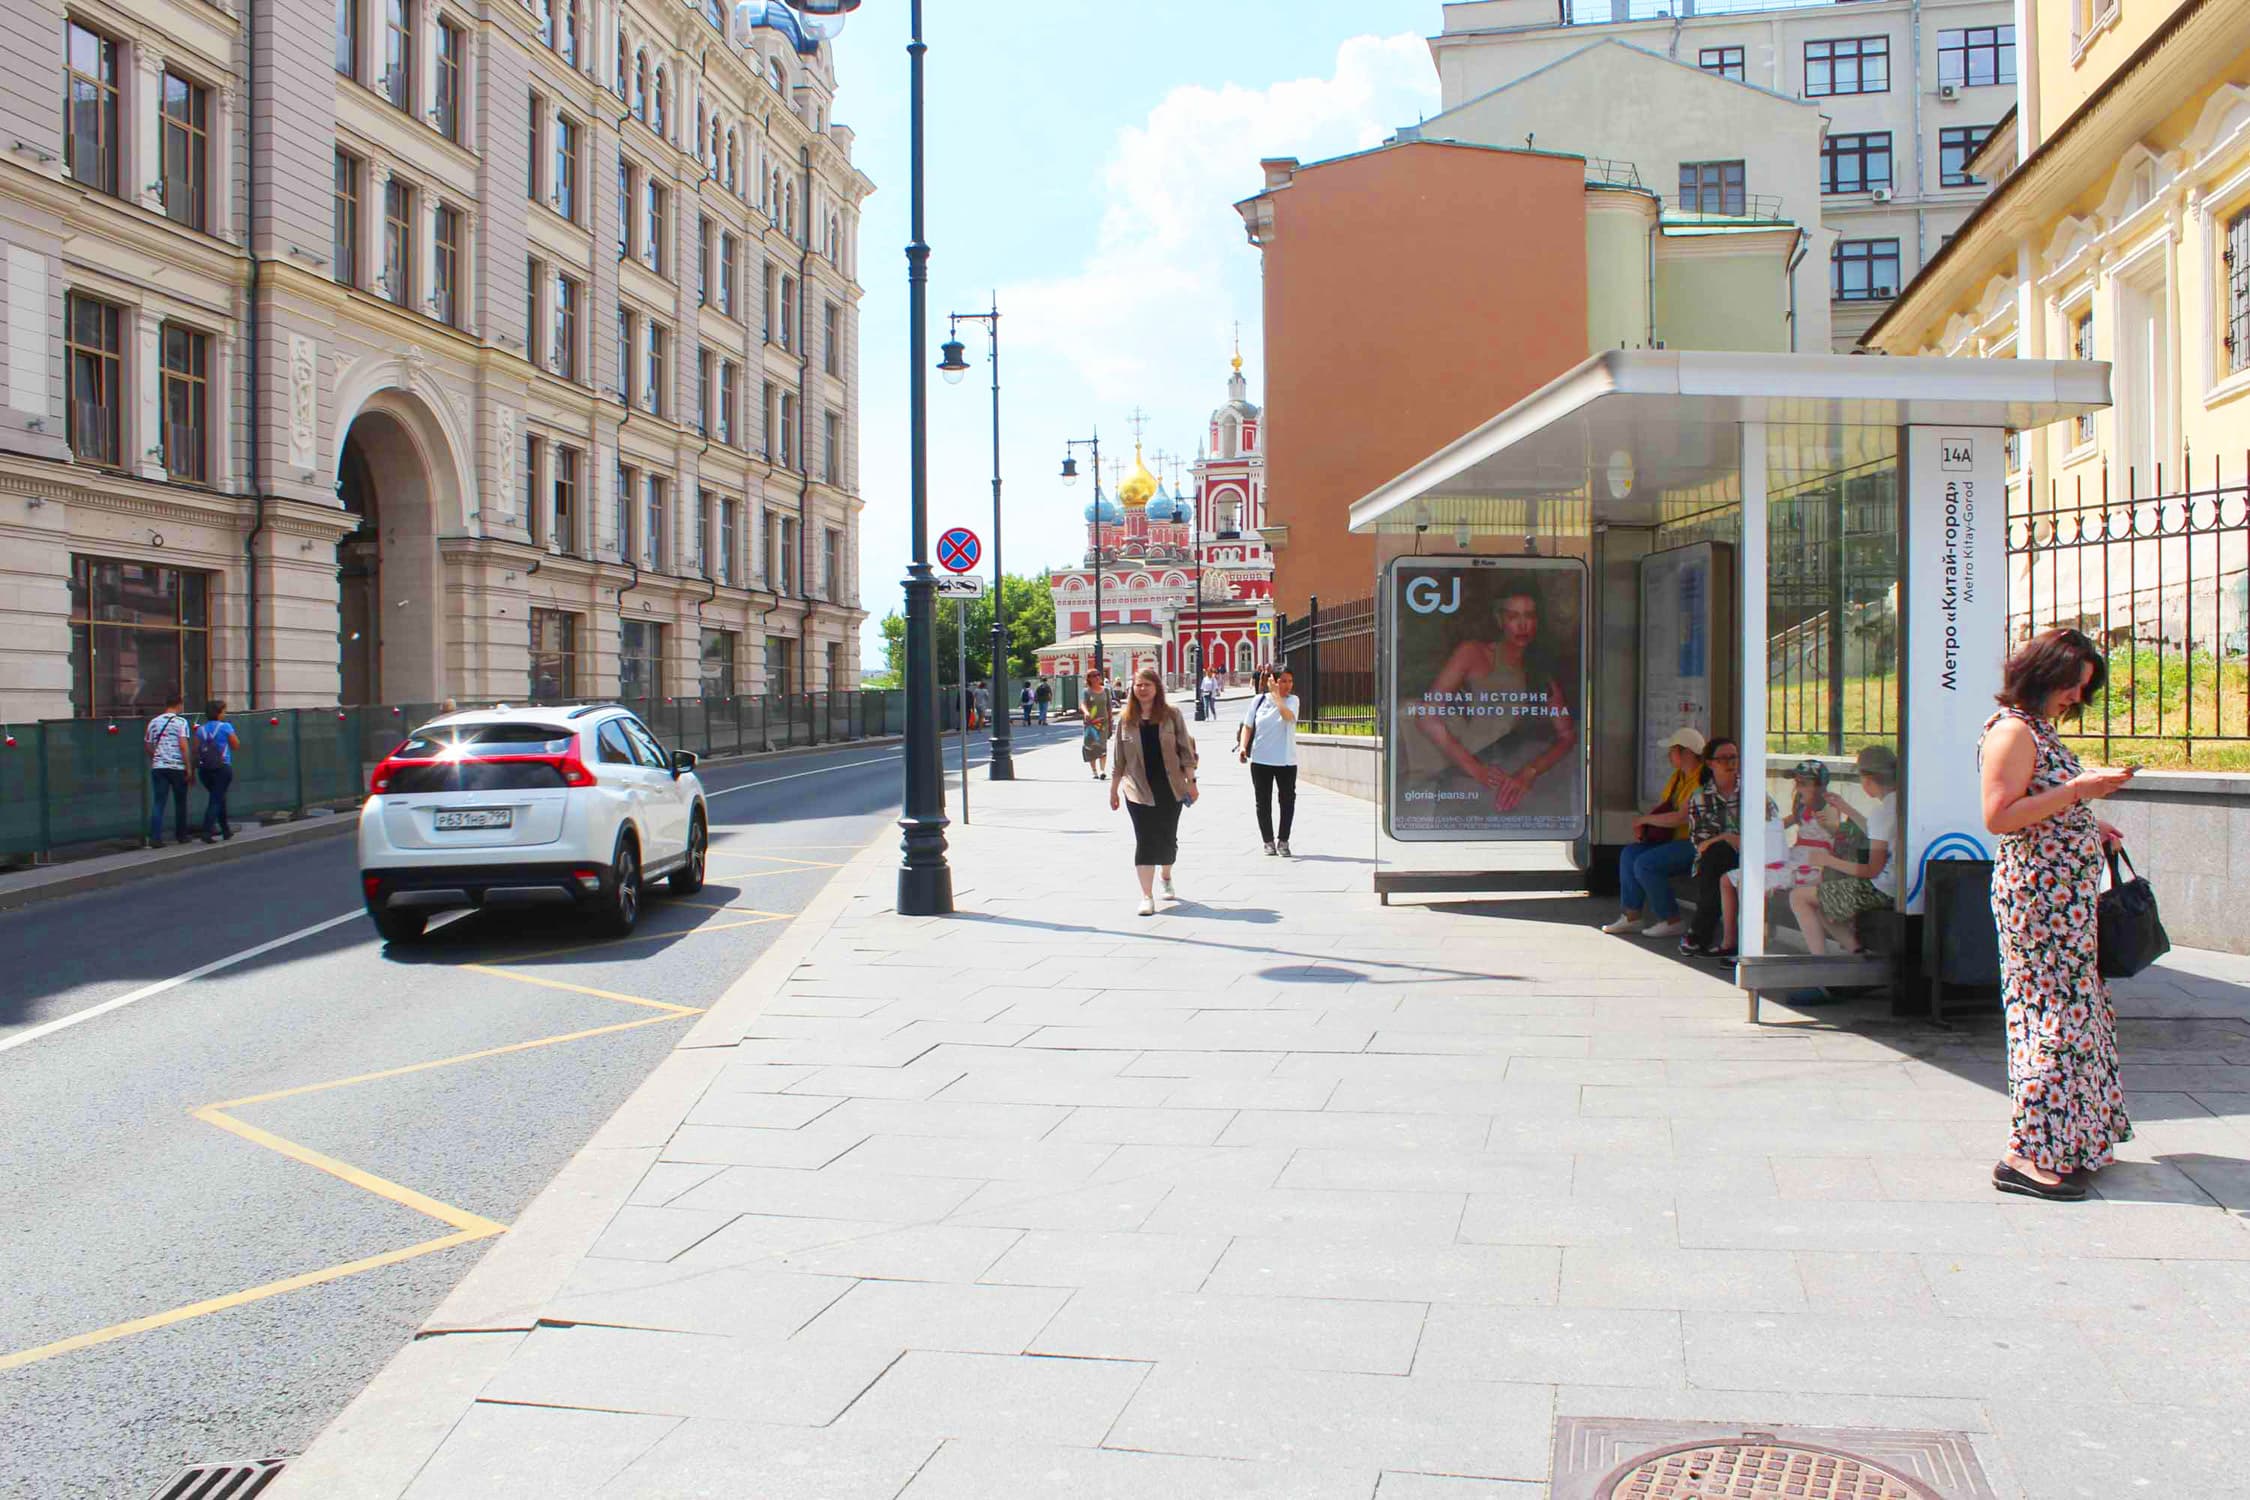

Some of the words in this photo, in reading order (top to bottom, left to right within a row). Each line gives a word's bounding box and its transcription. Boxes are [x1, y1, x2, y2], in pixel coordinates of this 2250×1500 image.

[1963, 480, 1975, 559] Kitay-Gorod
[1942, 481, 1960, 622] «Китай-город»
[1406, 576, 1460, 614] GJ
[1963, 562, 1974, 603] Metro
[1942, 624, 1960, 691] Метро
[1407, 706, 1504, 716] ИЗВЕСТНОГО
[1511, 706, 1569, 717] БРЕНДА
[1424, 692, 1473, 702] НОВАЯ
[1479, 692, 1548, 702] ИСТОРИЯ
[1404, 789, 1479, 802] gloria-jeans.ru
